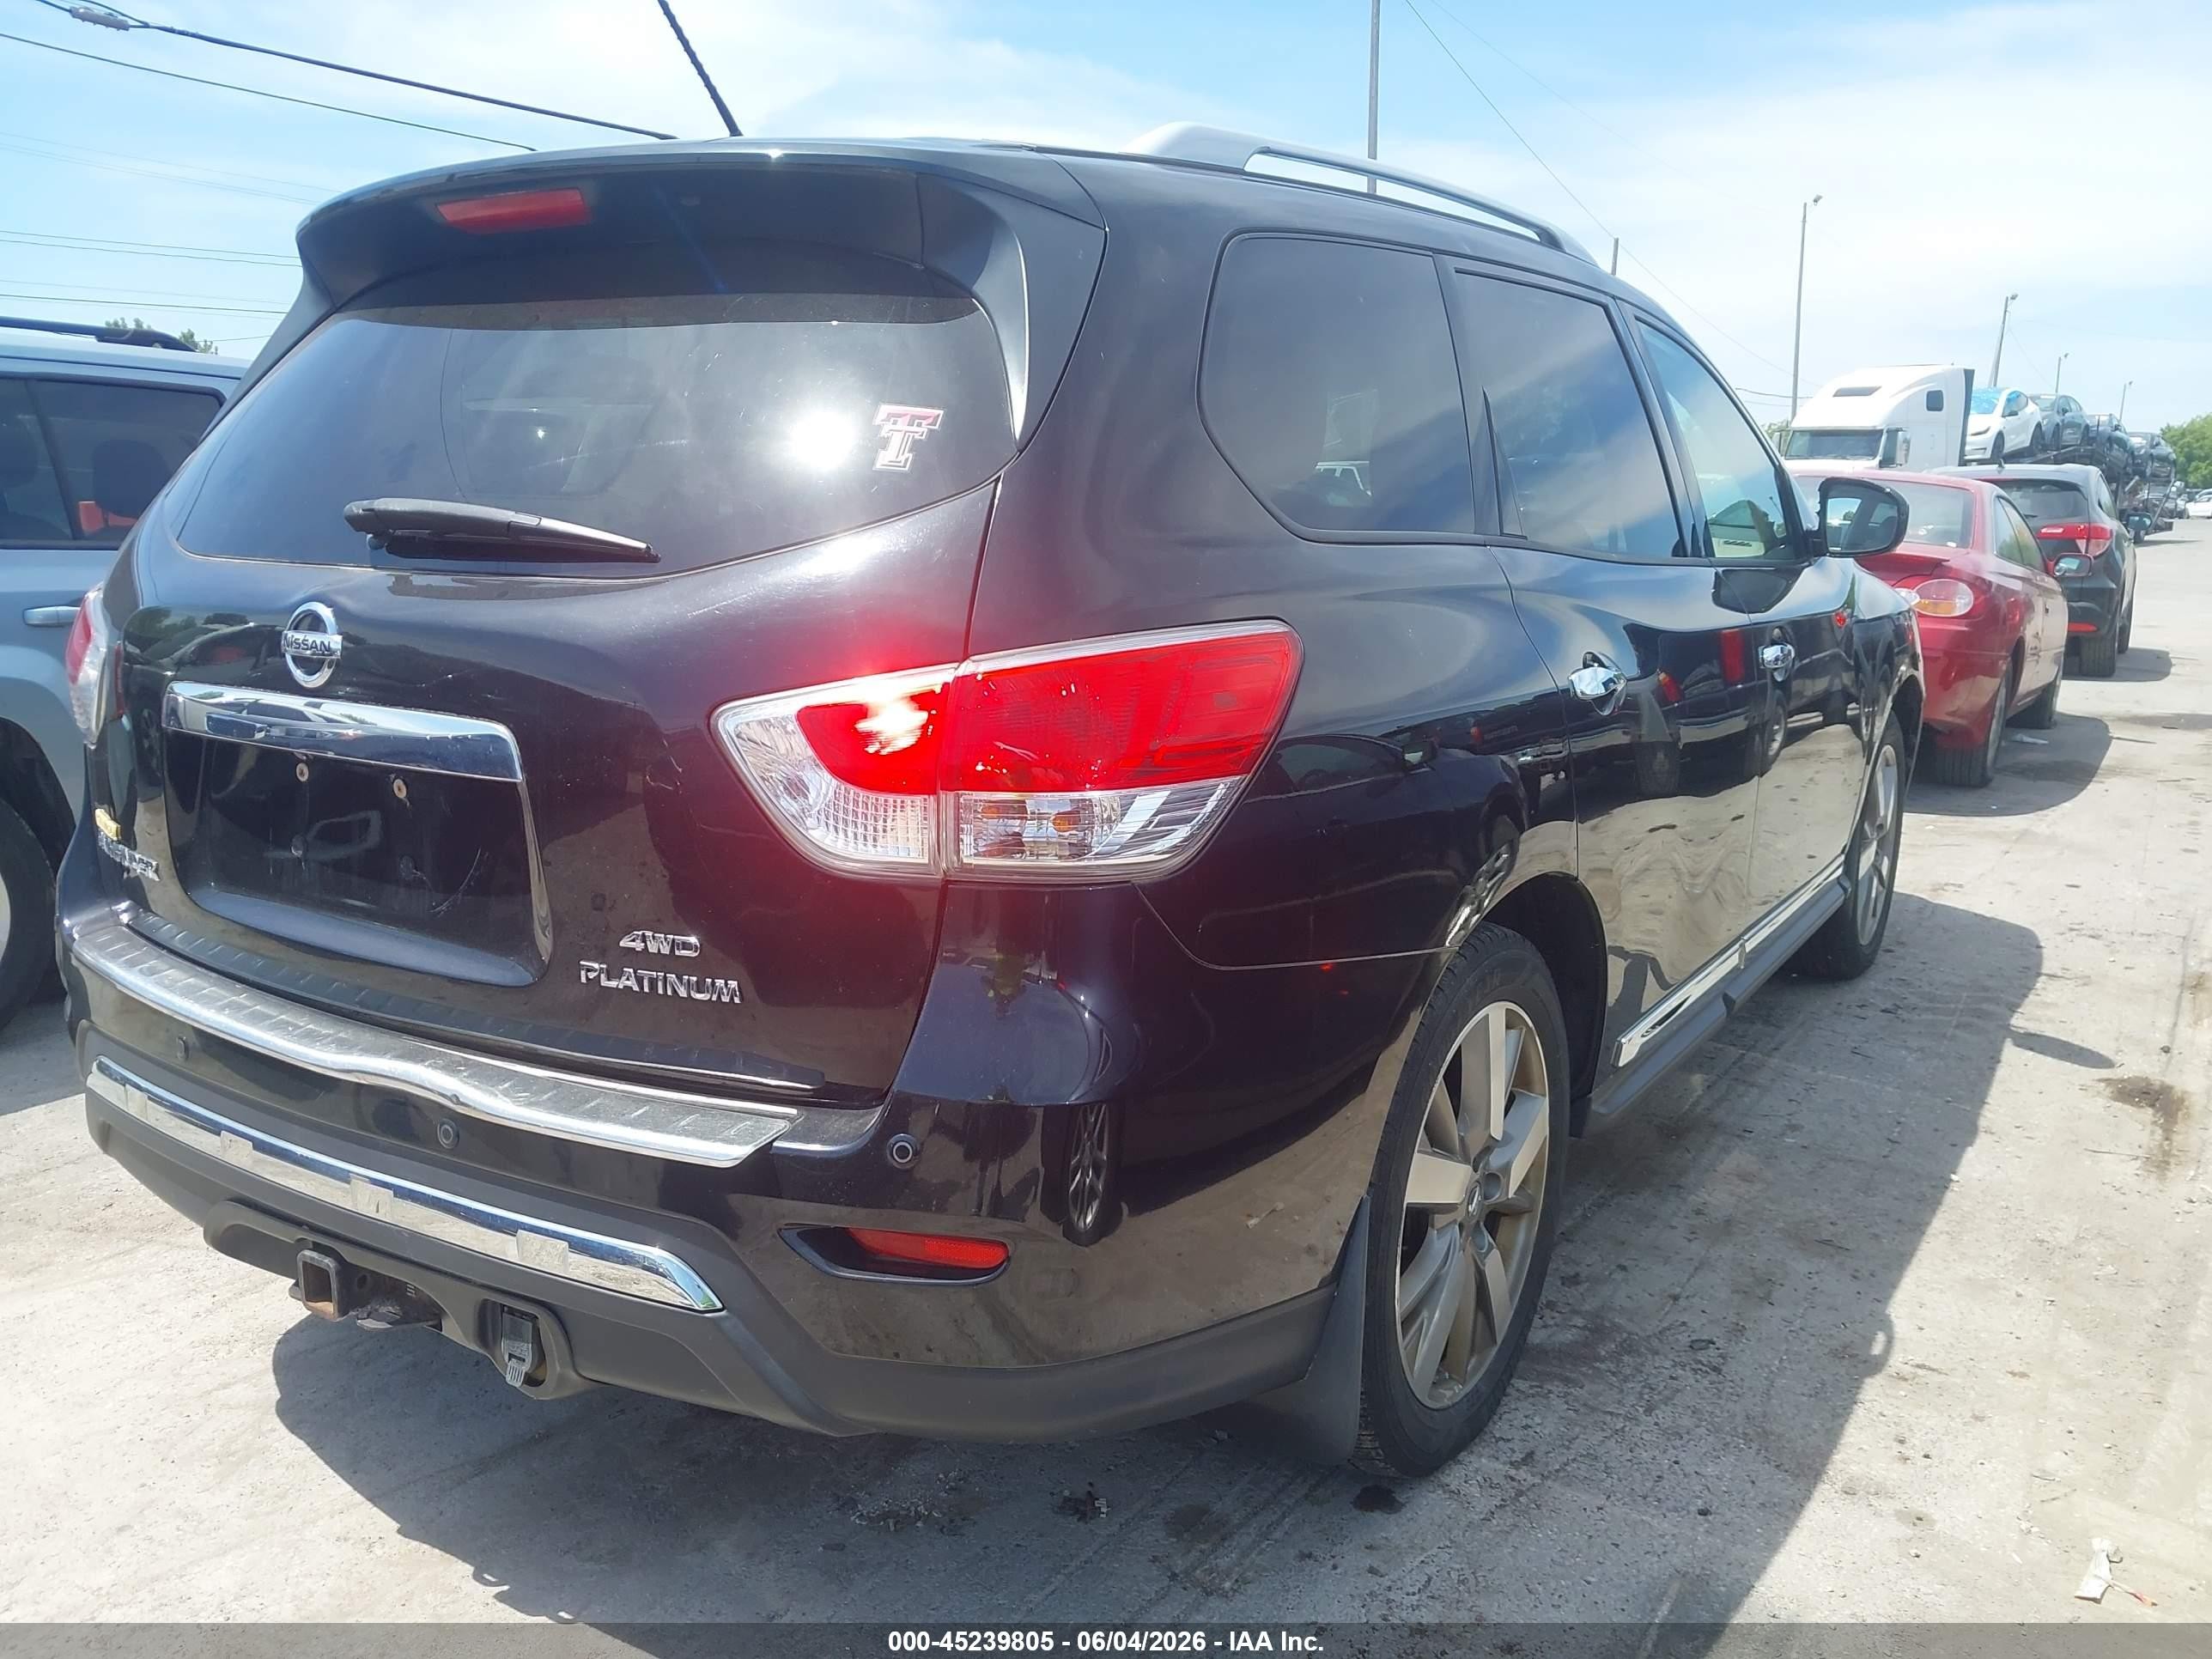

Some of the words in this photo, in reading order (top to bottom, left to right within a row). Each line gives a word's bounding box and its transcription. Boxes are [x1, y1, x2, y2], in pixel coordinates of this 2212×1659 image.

[283, 634, 331, 653] NISSAN
[618, 930, 701, 957] 4WD
[579, 960, 742, 1004] PLATINUM
